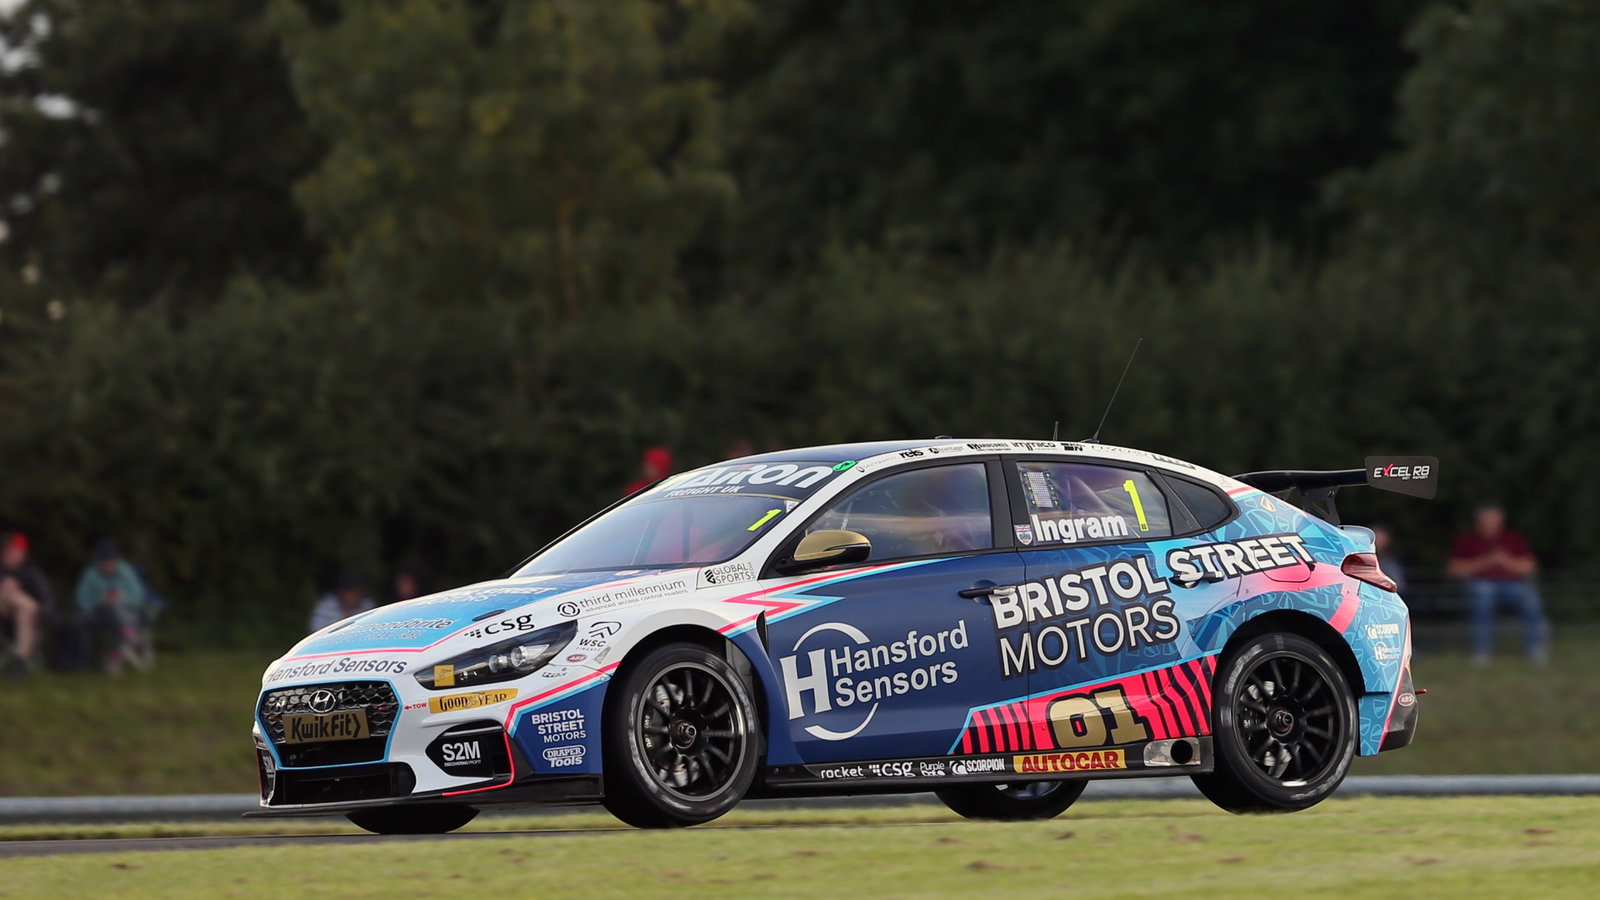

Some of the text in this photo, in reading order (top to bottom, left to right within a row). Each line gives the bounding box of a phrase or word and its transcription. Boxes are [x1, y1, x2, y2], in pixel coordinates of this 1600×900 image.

[1373, 464, 1430, 478] EXCEL R8
[720, 485, 745, 493] UK
[1122, 480, 1149, 531] 1
[747, 509, 782, 531] 1
[1031, 514, 1128, 544] Ingram
[712, 563, 748, 575] GLOBAL
[715, 571, 751, 584] SPORTS
[988, 535, 1314, 629] BRISTOL STREET
[580, 578, 686, 608] third millennium
[485, 614, 534, 635] csg
[579, 638, 606, 647] WSC
[1000, 600, 1178, 676] MOTORS
[830, 620, 968, 676] Hansford
[265, 657, 407, 683] Hansford Sensors
[835, 661, 958, 707] Sensors
[531, 709, 584, 725] BRISTOL
[1050, 689, 1147, 748] 01
[538, 719, 585, 735] STREET
[543, 730, 586, 743] MOTORS
[442, 741, 480, 761] S2M
[547, 747, 582, 758] DRAPER
[550, 756, 583, 767] Tools
[881, 762, 916, 777] csg
[966, 758, 1005, 772] SCORPION
[1022, 751, 1120, 772] AUTOCAR
[821, 766, 864, 779] rocket
